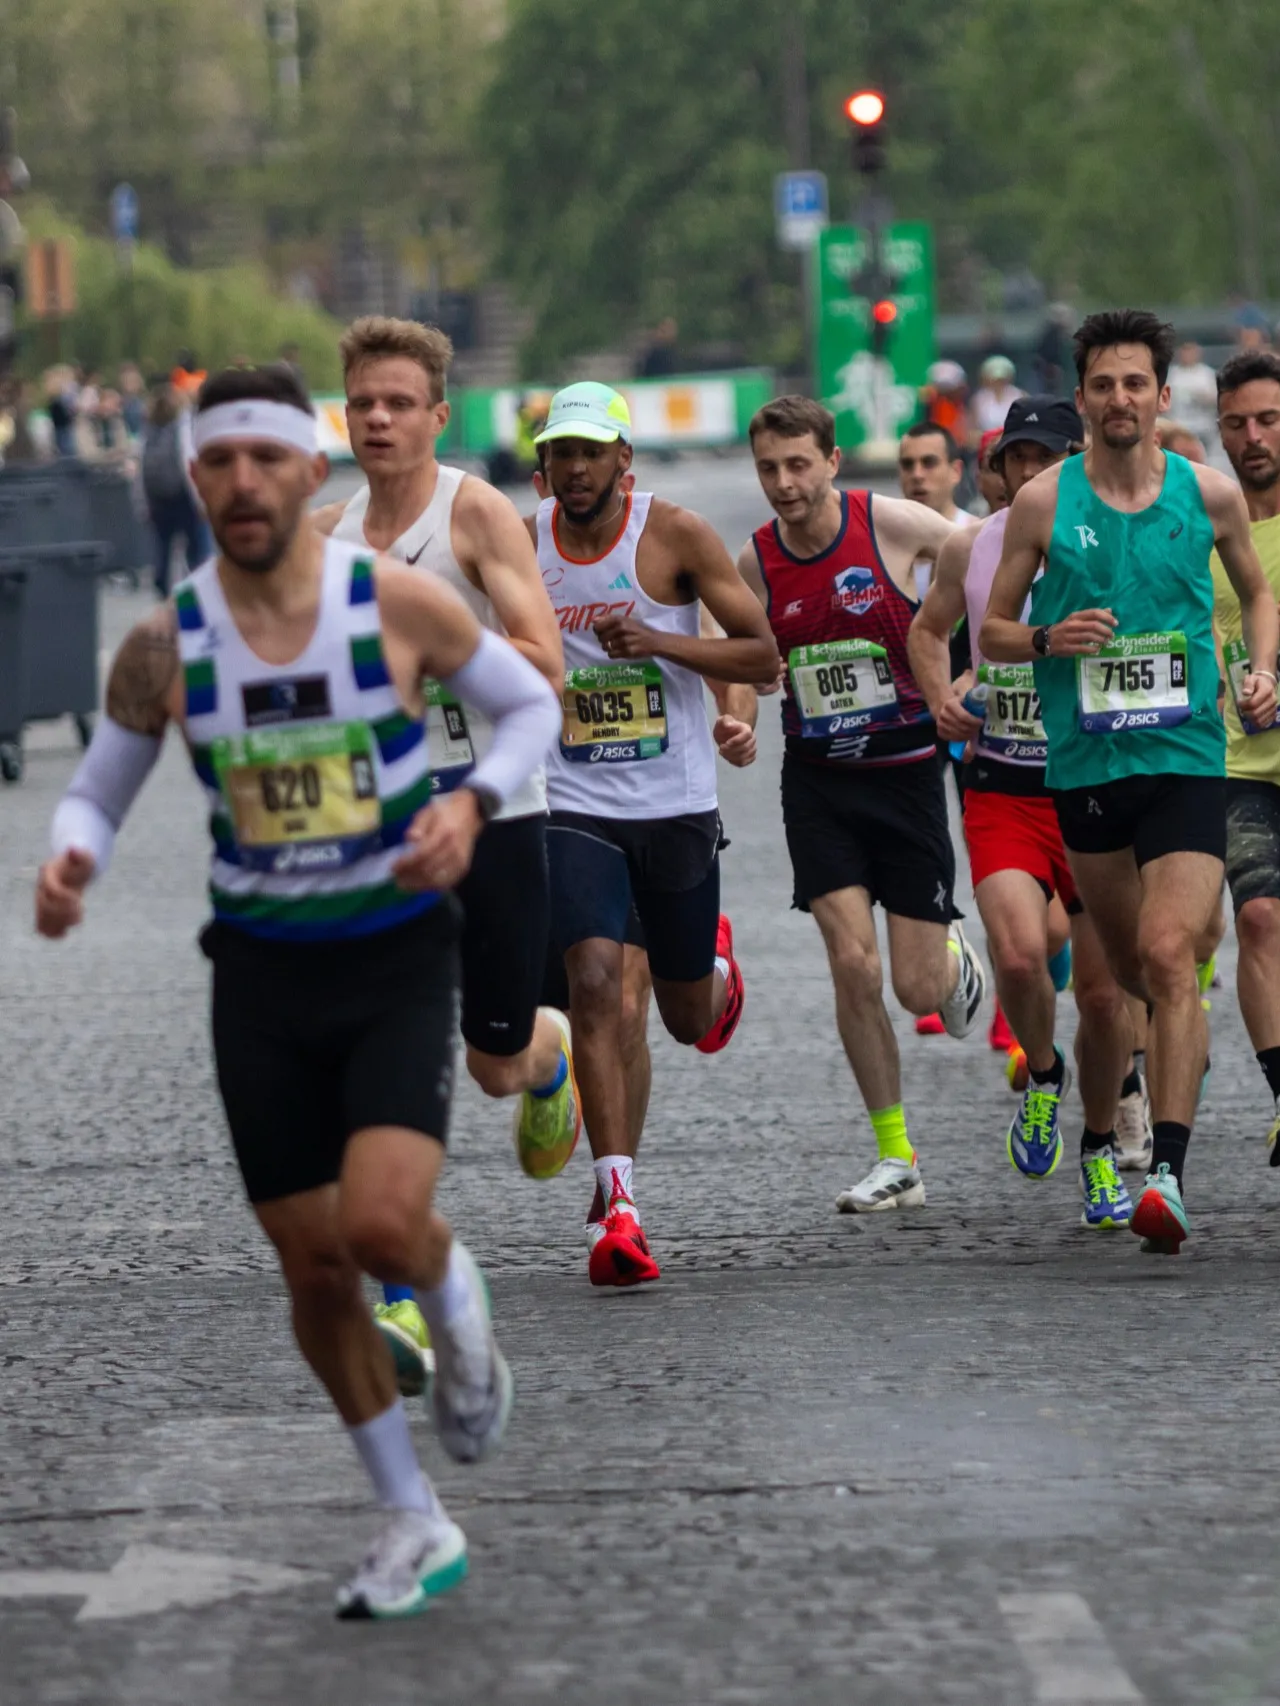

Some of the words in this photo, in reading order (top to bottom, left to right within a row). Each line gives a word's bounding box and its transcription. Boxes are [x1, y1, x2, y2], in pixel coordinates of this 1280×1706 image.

[562, 401, 591, 410] KIPRUN
[1106, 633, 1173, 649] Schneider
[579, 665, 645, 682] Schneider
[816, 663, 858, 697] 805
[1100, 659, 1155, 692] 7155
[575, 690, 634, 724] 6035
[842, 713, 871, 729] asics
[1126, 712, 1160, 725] asics
[603, 745, 636, 759] asics
[1018, 745, 1048, 757] asics
